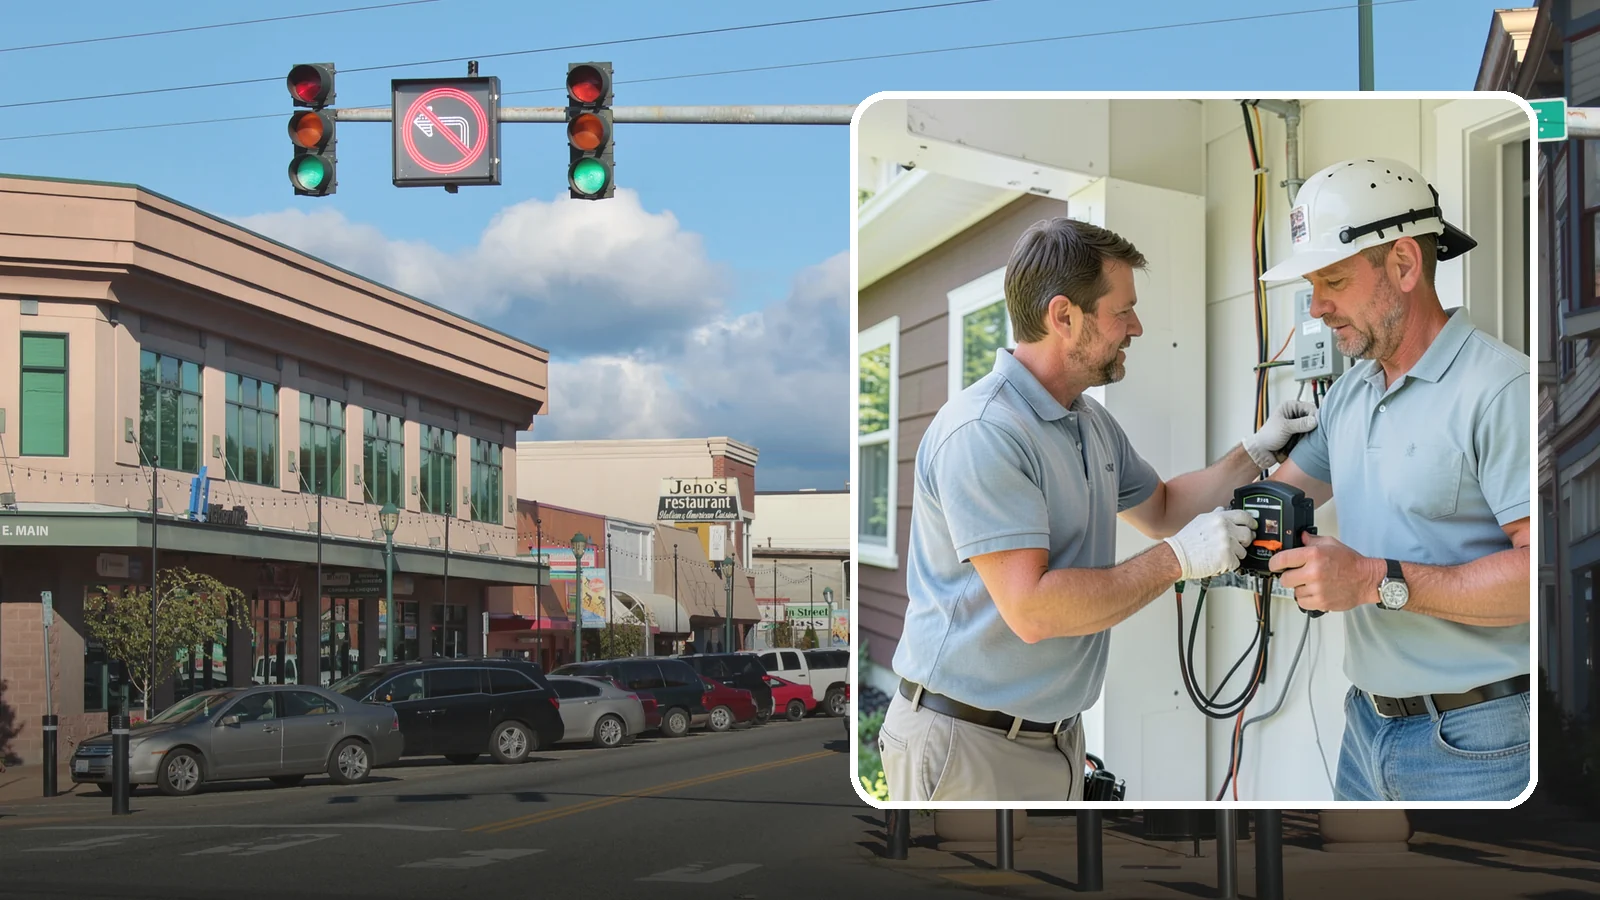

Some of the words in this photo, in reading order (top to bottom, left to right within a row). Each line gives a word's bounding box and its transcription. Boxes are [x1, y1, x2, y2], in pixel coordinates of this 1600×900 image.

[670, 480, 727, 494] Jeno's
[665, 496, 731, 508] restaurant
[659, 510, 681, 519] Italian
[686, 510, 714, 519] American
[715, 509, 737, 518] Cuisine
[2, 525, 13, 536] E.
[16, 525, 49, 536] MAIN
[797, 607, 828, 616] Street
[791, 619, 824, 627] lass
